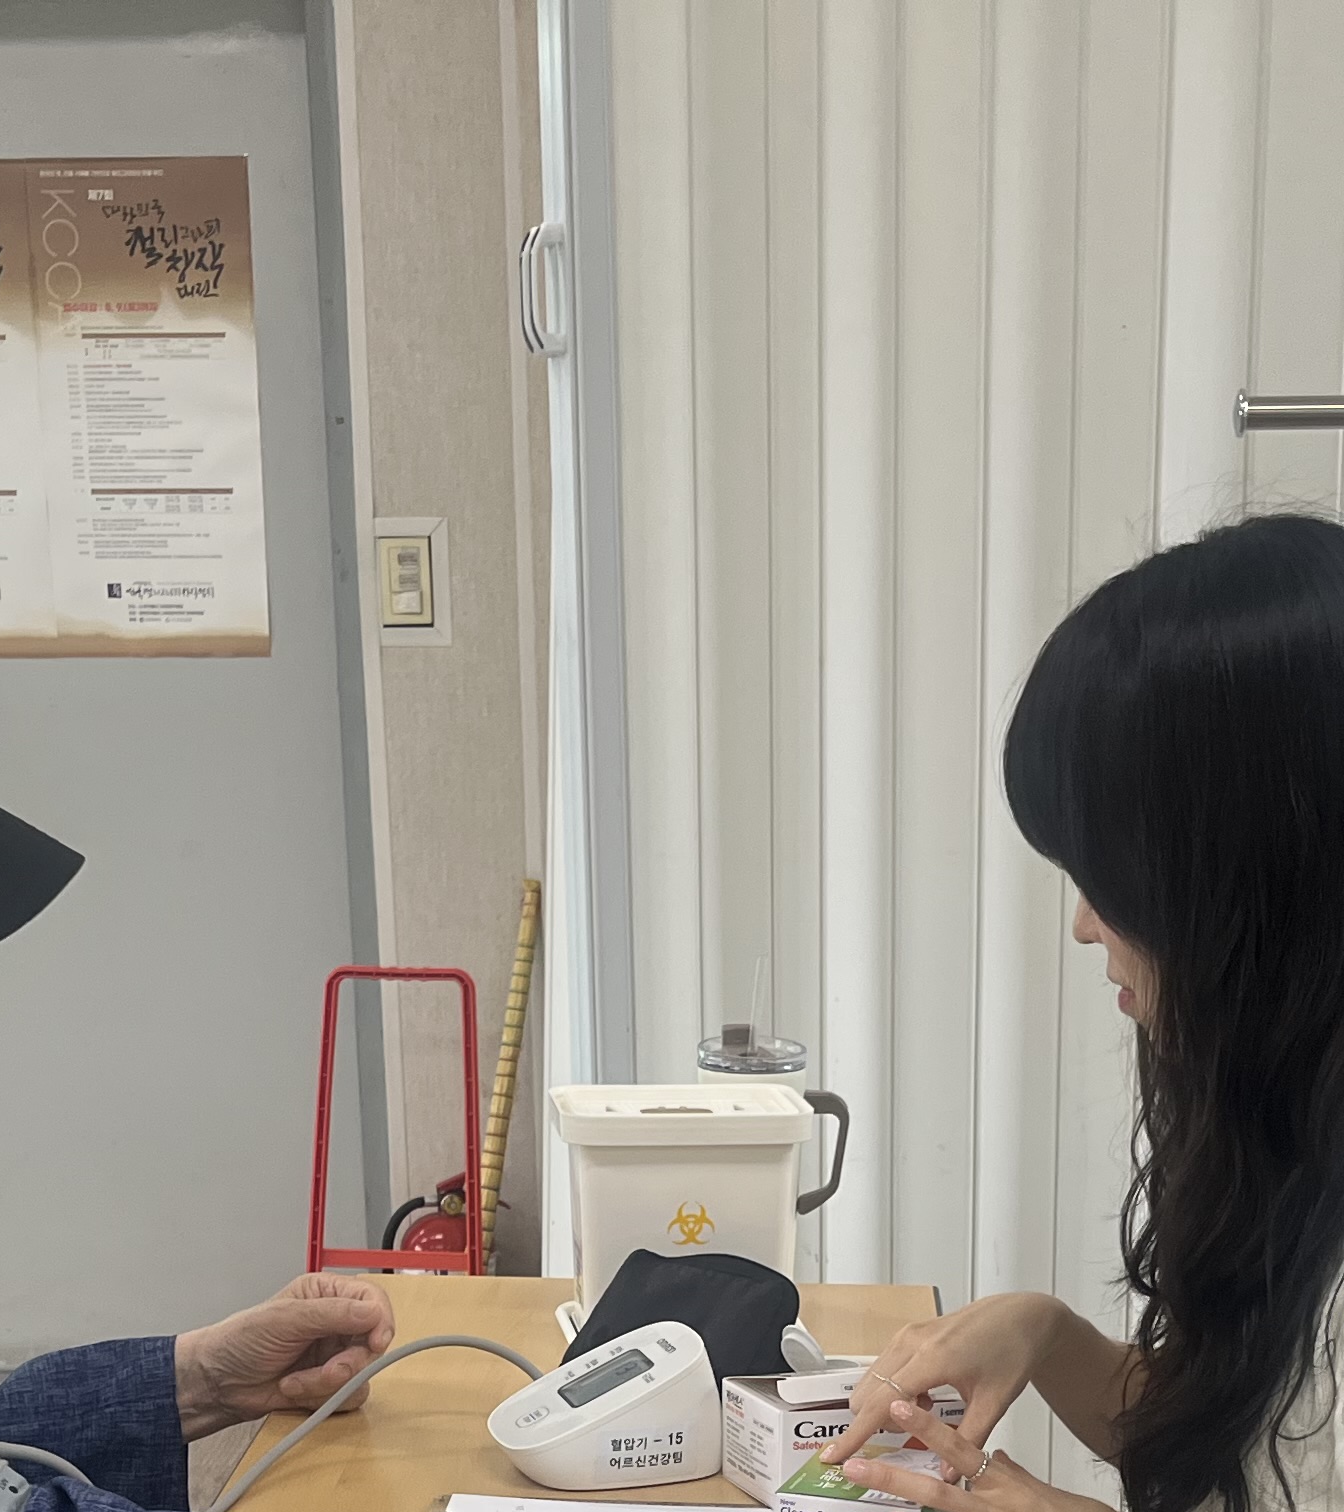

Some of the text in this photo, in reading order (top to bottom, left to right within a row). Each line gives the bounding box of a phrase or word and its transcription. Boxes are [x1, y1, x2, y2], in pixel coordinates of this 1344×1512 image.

[101, 199, 165, 224] 대한민국
[165, 240, 225, 288] 창작
[177, 279, 219, 298] 대전
[794, 1421, 850, 1439] Care
[610, 1437, 647, 1451] 혈압기
[668, 1432, 684, 1446] 15
[609, 1451, 683, 1470] 어르신건강팀
[779, 1498, 796, 1506] New
